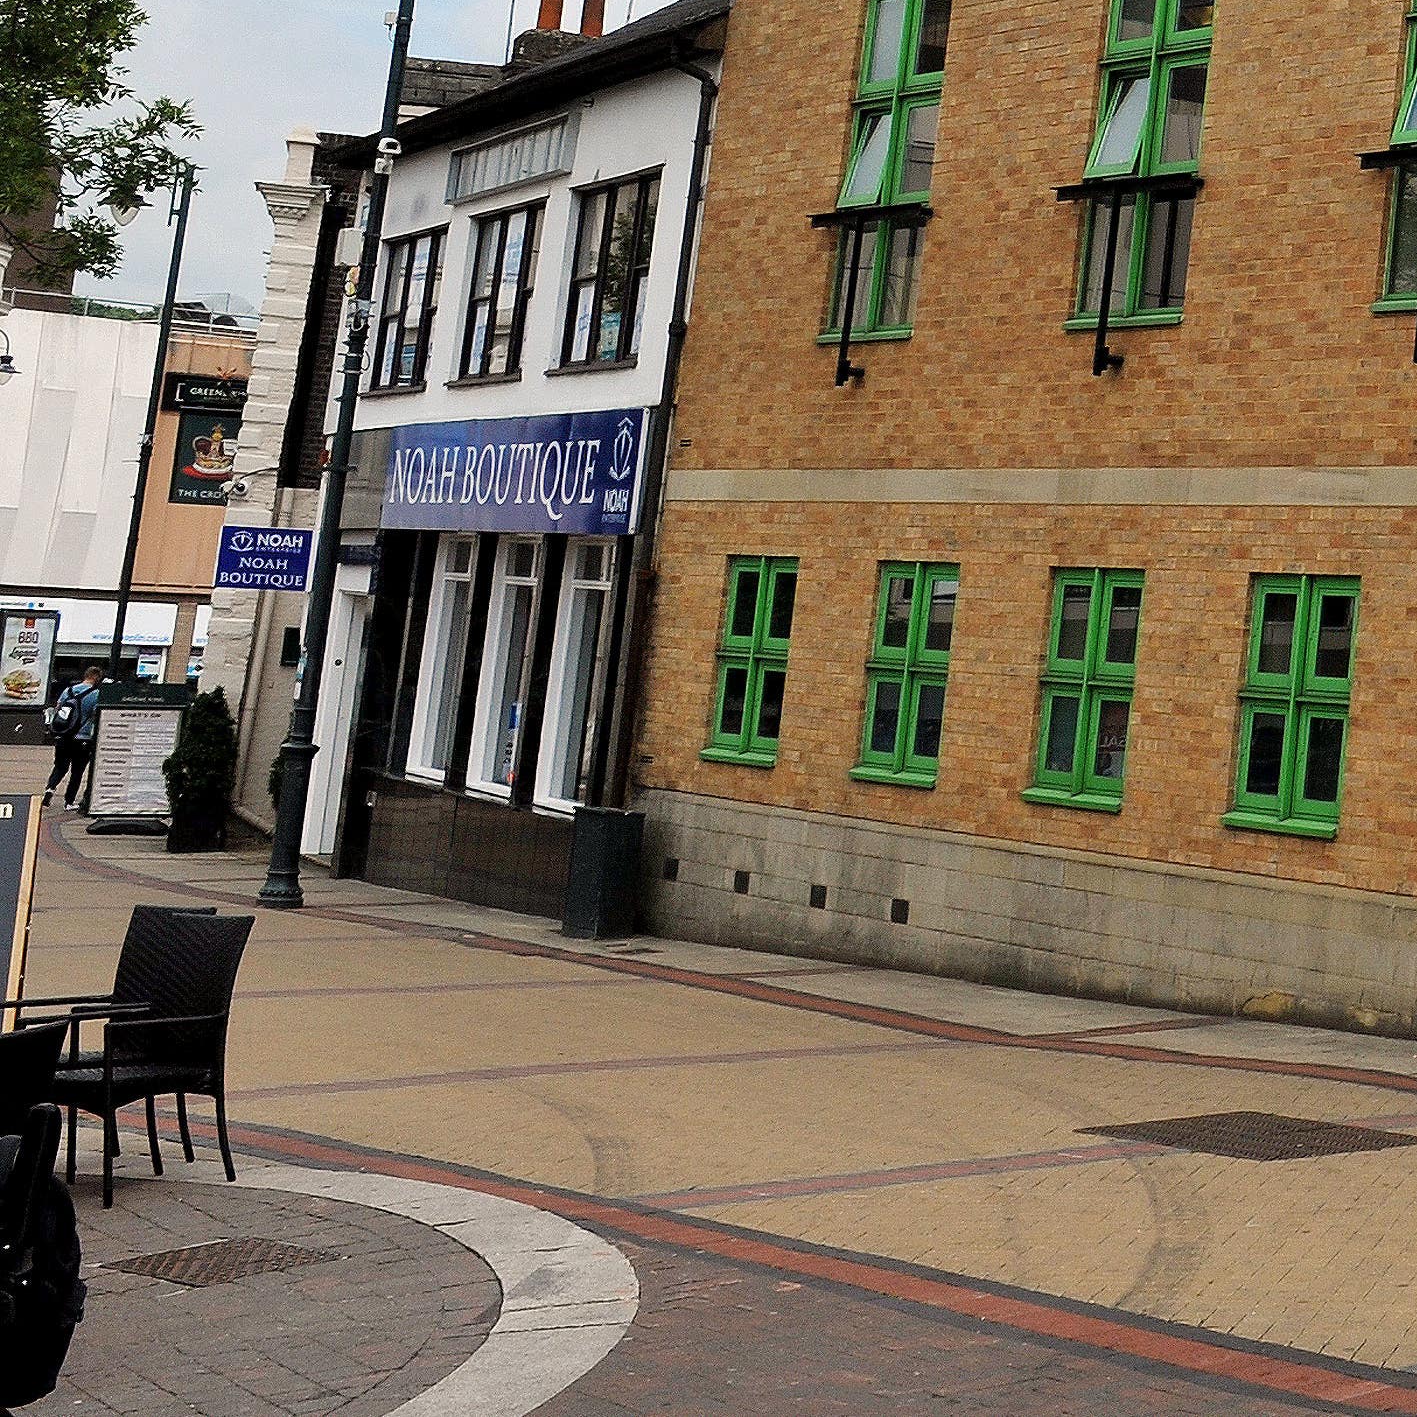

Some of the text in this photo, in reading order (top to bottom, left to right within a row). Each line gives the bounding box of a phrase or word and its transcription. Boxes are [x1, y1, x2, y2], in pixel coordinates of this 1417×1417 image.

[388, 439, 601, 521] NOAH BOUTIQUE
[602, 489, 630, 513] NOAH
[256, 533, 304, 548] NOAH
[239, 556, 289, 570] NOAH
[218, 571, 305, 588] BOUTIQUE
